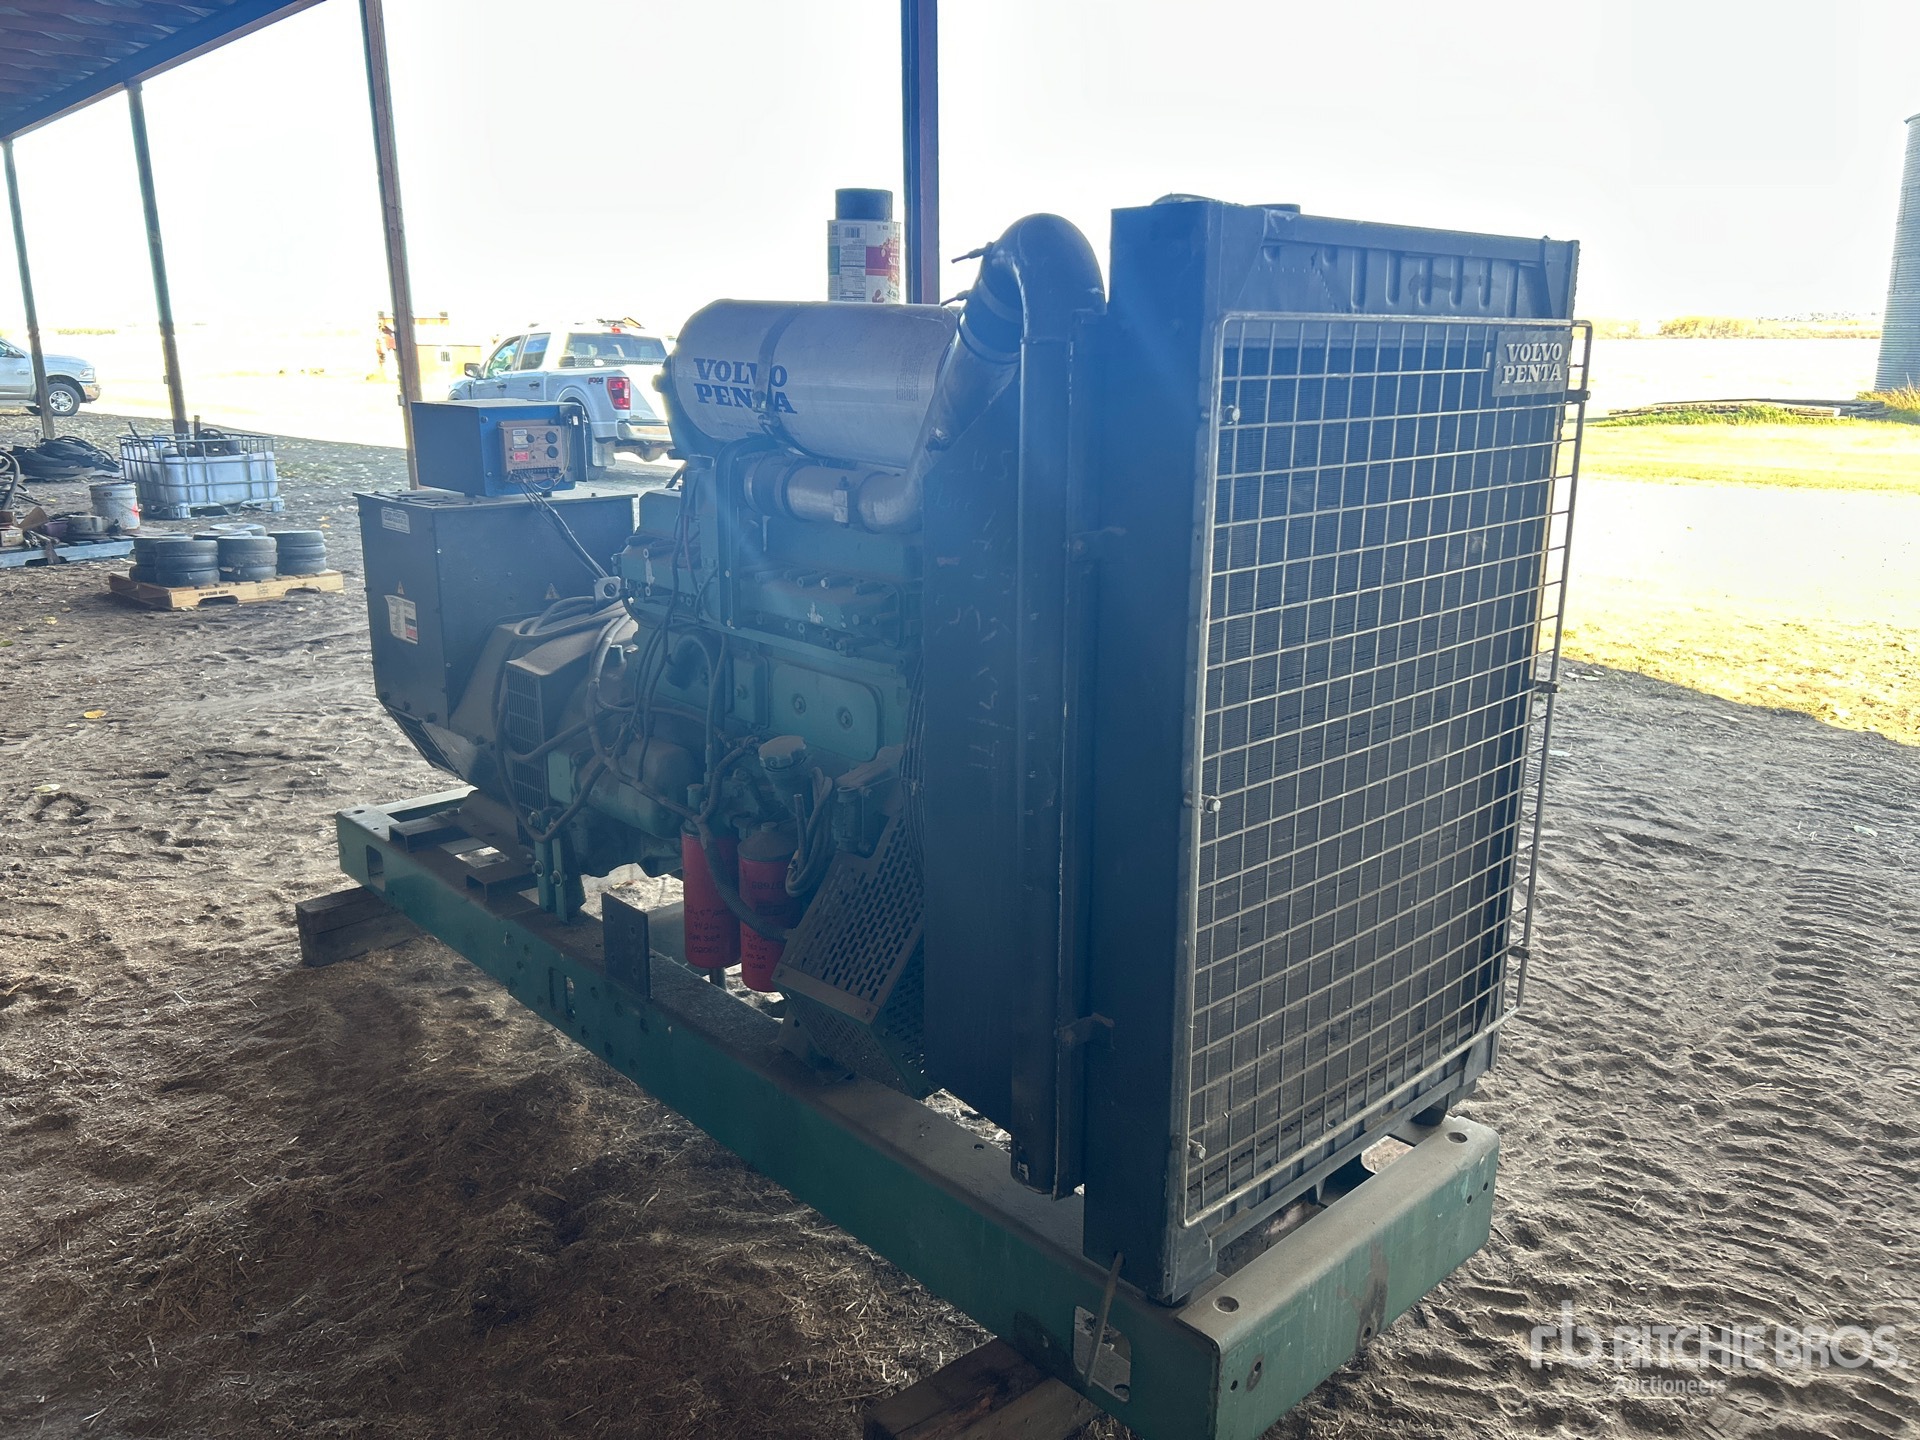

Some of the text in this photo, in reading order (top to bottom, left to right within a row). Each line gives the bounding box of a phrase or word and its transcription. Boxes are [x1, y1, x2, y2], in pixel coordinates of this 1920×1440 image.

[1506, 342, 1563, 362] VOLVO
[1501, 363, 1563, 384] PENTA
[693, 382, 798, 414] PENA
